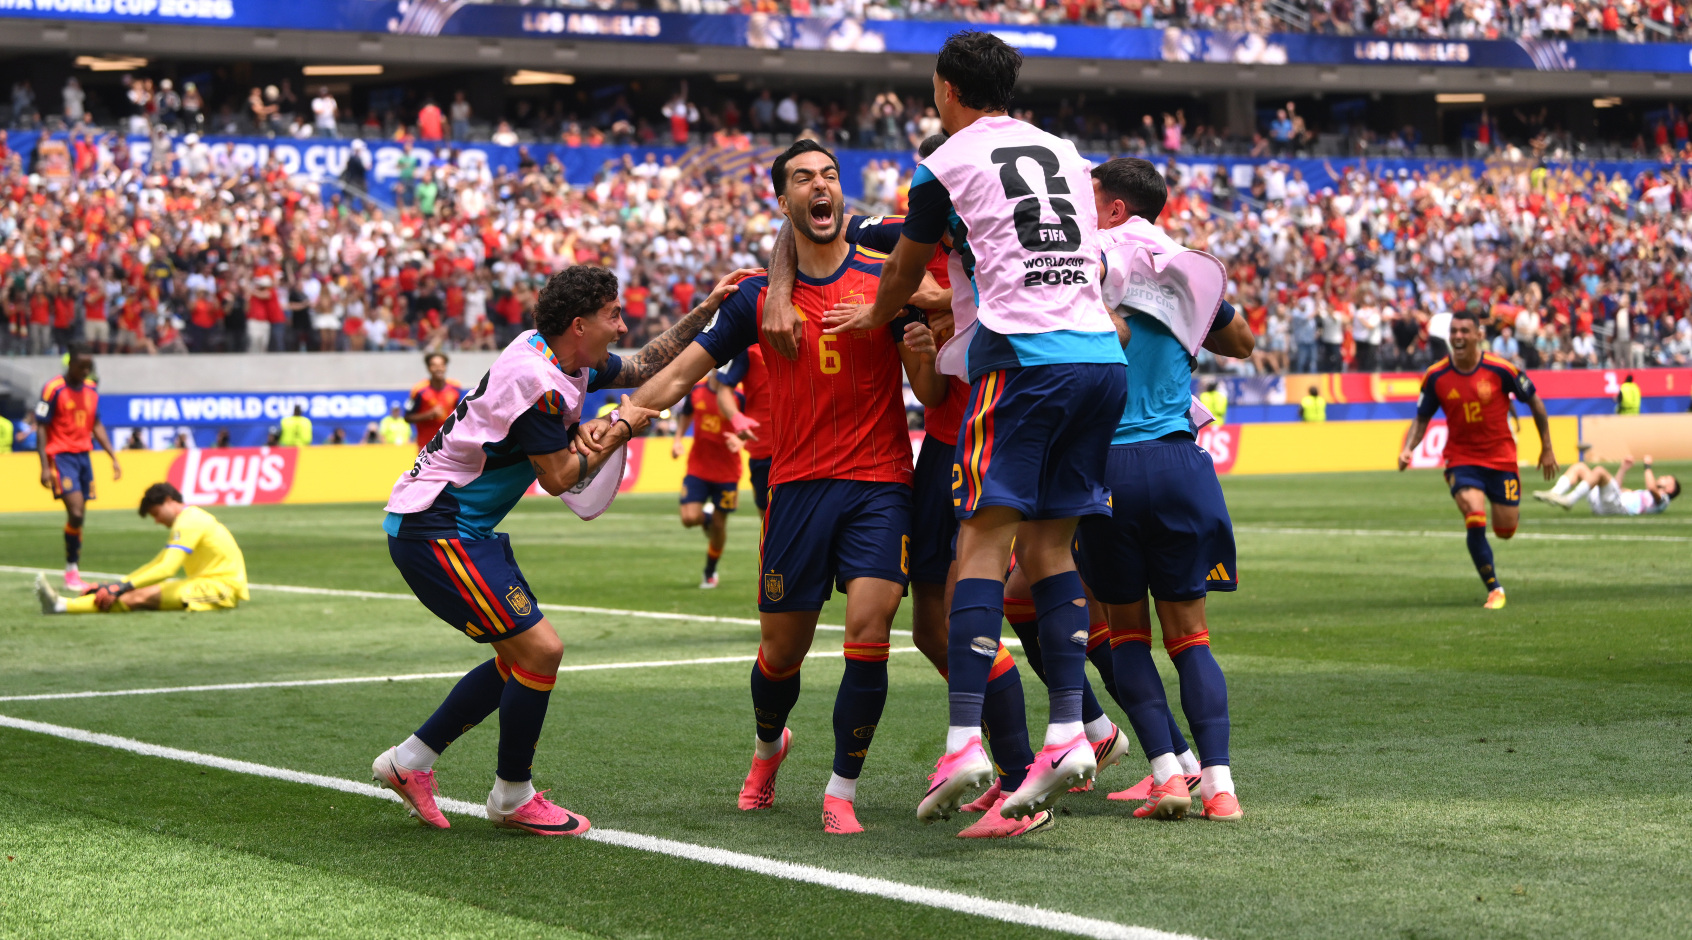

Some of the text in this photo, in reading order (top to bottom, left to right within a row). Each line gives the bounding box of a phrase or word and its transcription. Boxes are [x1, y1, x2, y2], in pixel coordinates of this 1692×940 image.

[157, 0, 235, 20] 2026
[522, 11, 565, 33] LOS
[1354, 41, 1390, 61] LOS
[1038, 228, 1068, 242] FIFA
[1023, 257, 1084, 269] WORLD CUP
[1024, 269, 1089, 288] 2026
[818, 334, 841, 375] 6
[128, 398, 180, 421] FIFA
[180, 397, 263, 420] WORLD
[310, 394, 388, 418] 2026
[1463, 401, 1483, 424] 12
[181, 446, 286, 506] Lay's
[1504, 478, 1519, 501] 12
